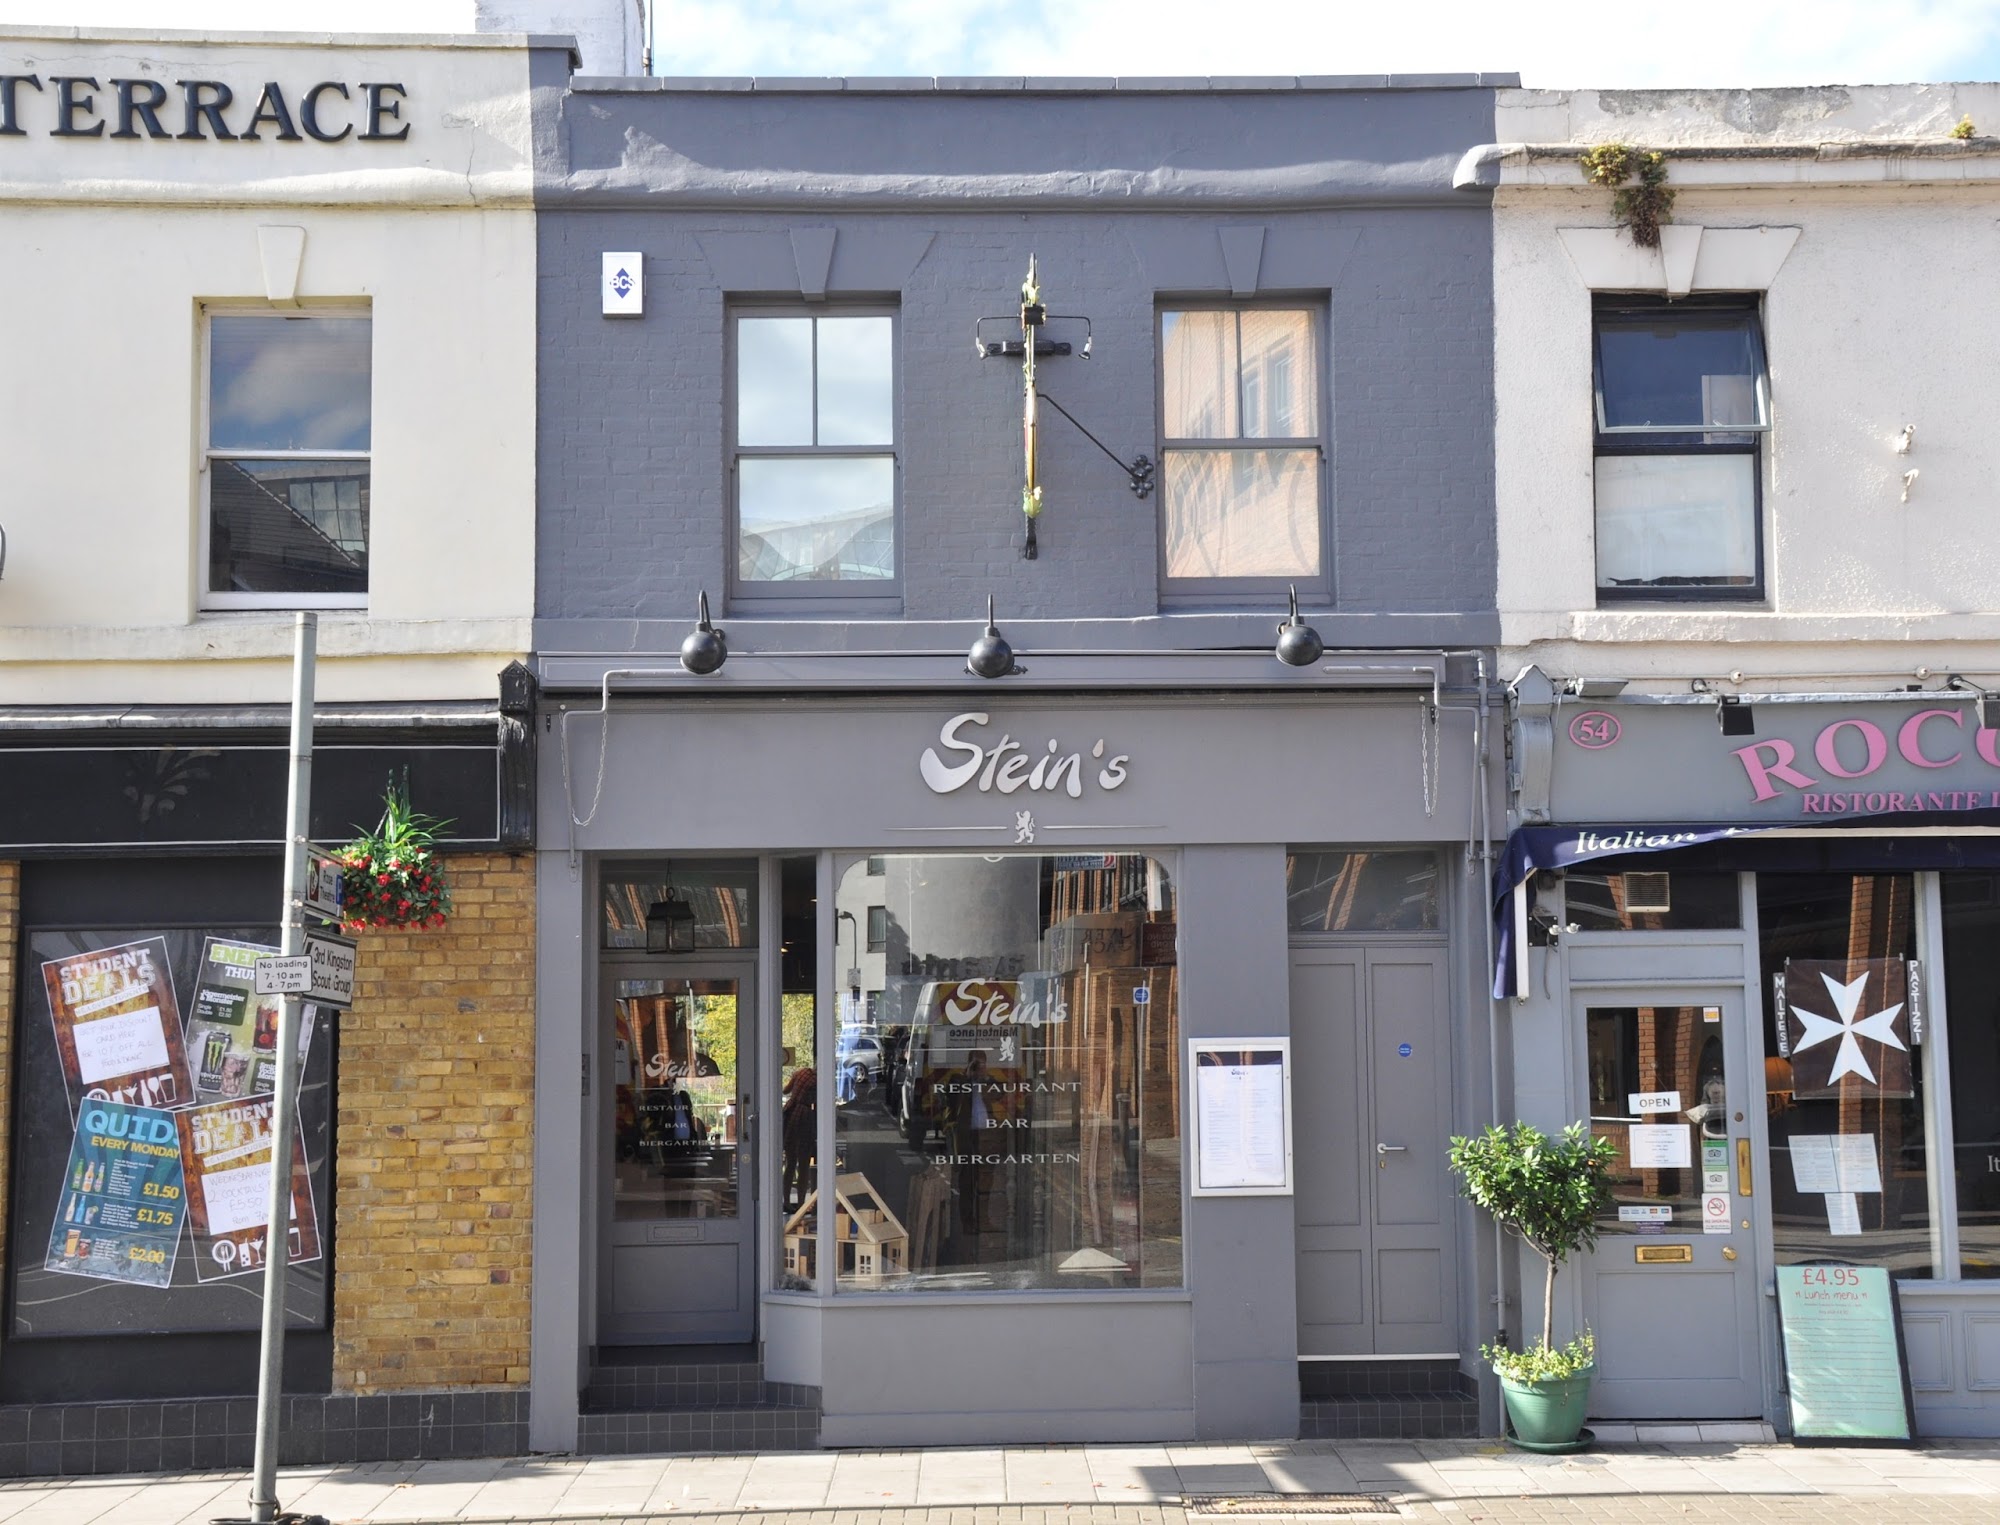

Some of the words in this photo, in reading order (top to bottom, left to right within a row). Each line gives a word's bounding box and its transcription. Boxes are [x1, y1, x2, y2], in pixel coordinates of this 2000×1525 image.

[0, 74, 411, 142] TERRACE
[1579, 719, 1609, 742] 54
[920, 712, 1129, 798] Stein's
[1802, 791, 1982, 813] RISTORANTE
[1575, 830, 1697, 855] Italian
[60, 948, 151, 982] STUDENT
[275, 960, 308, 970] loading
[313, 946, 326, 965] 3rd
[327, 951, 353, 972] Kingston
[62, 964, 156, 1006] DEALS
[312, 971, 331, 990] Scout
[333, 977, 351, 997] Group
[945, 978, 1068, 1028] Stein's
[1910, 960, 1921, 1043] PASTIZZI
[1775, 975, 1789, 1053] MALTESE
[645, 1053, 708, 1077] Stein's
[933, 1082, 1082, 1094] RESTAURANT
[639, 1104, 690, 1112] RESTAUR
[1639, 1098, 1671, 1108] OPEN
[985, 1119, 1029, 1129] BAR
[91, 1136, 129, 1151] EVERY
[130, 1142, 180, 1159] MONDAY
[934, 1153, 1081, 1165] BIERGARTEN
[143, 1182, 179, 1200] £1.50
[136, 1208, 173, 1226] £1.75
[128, 1247, 166, 1264] £2.00
[1803, 1268, 1859, 1286] £4.95
[1805, 1290, 1830, 1300] Lunch
[1833, 1291, 1859, 1300] menu
